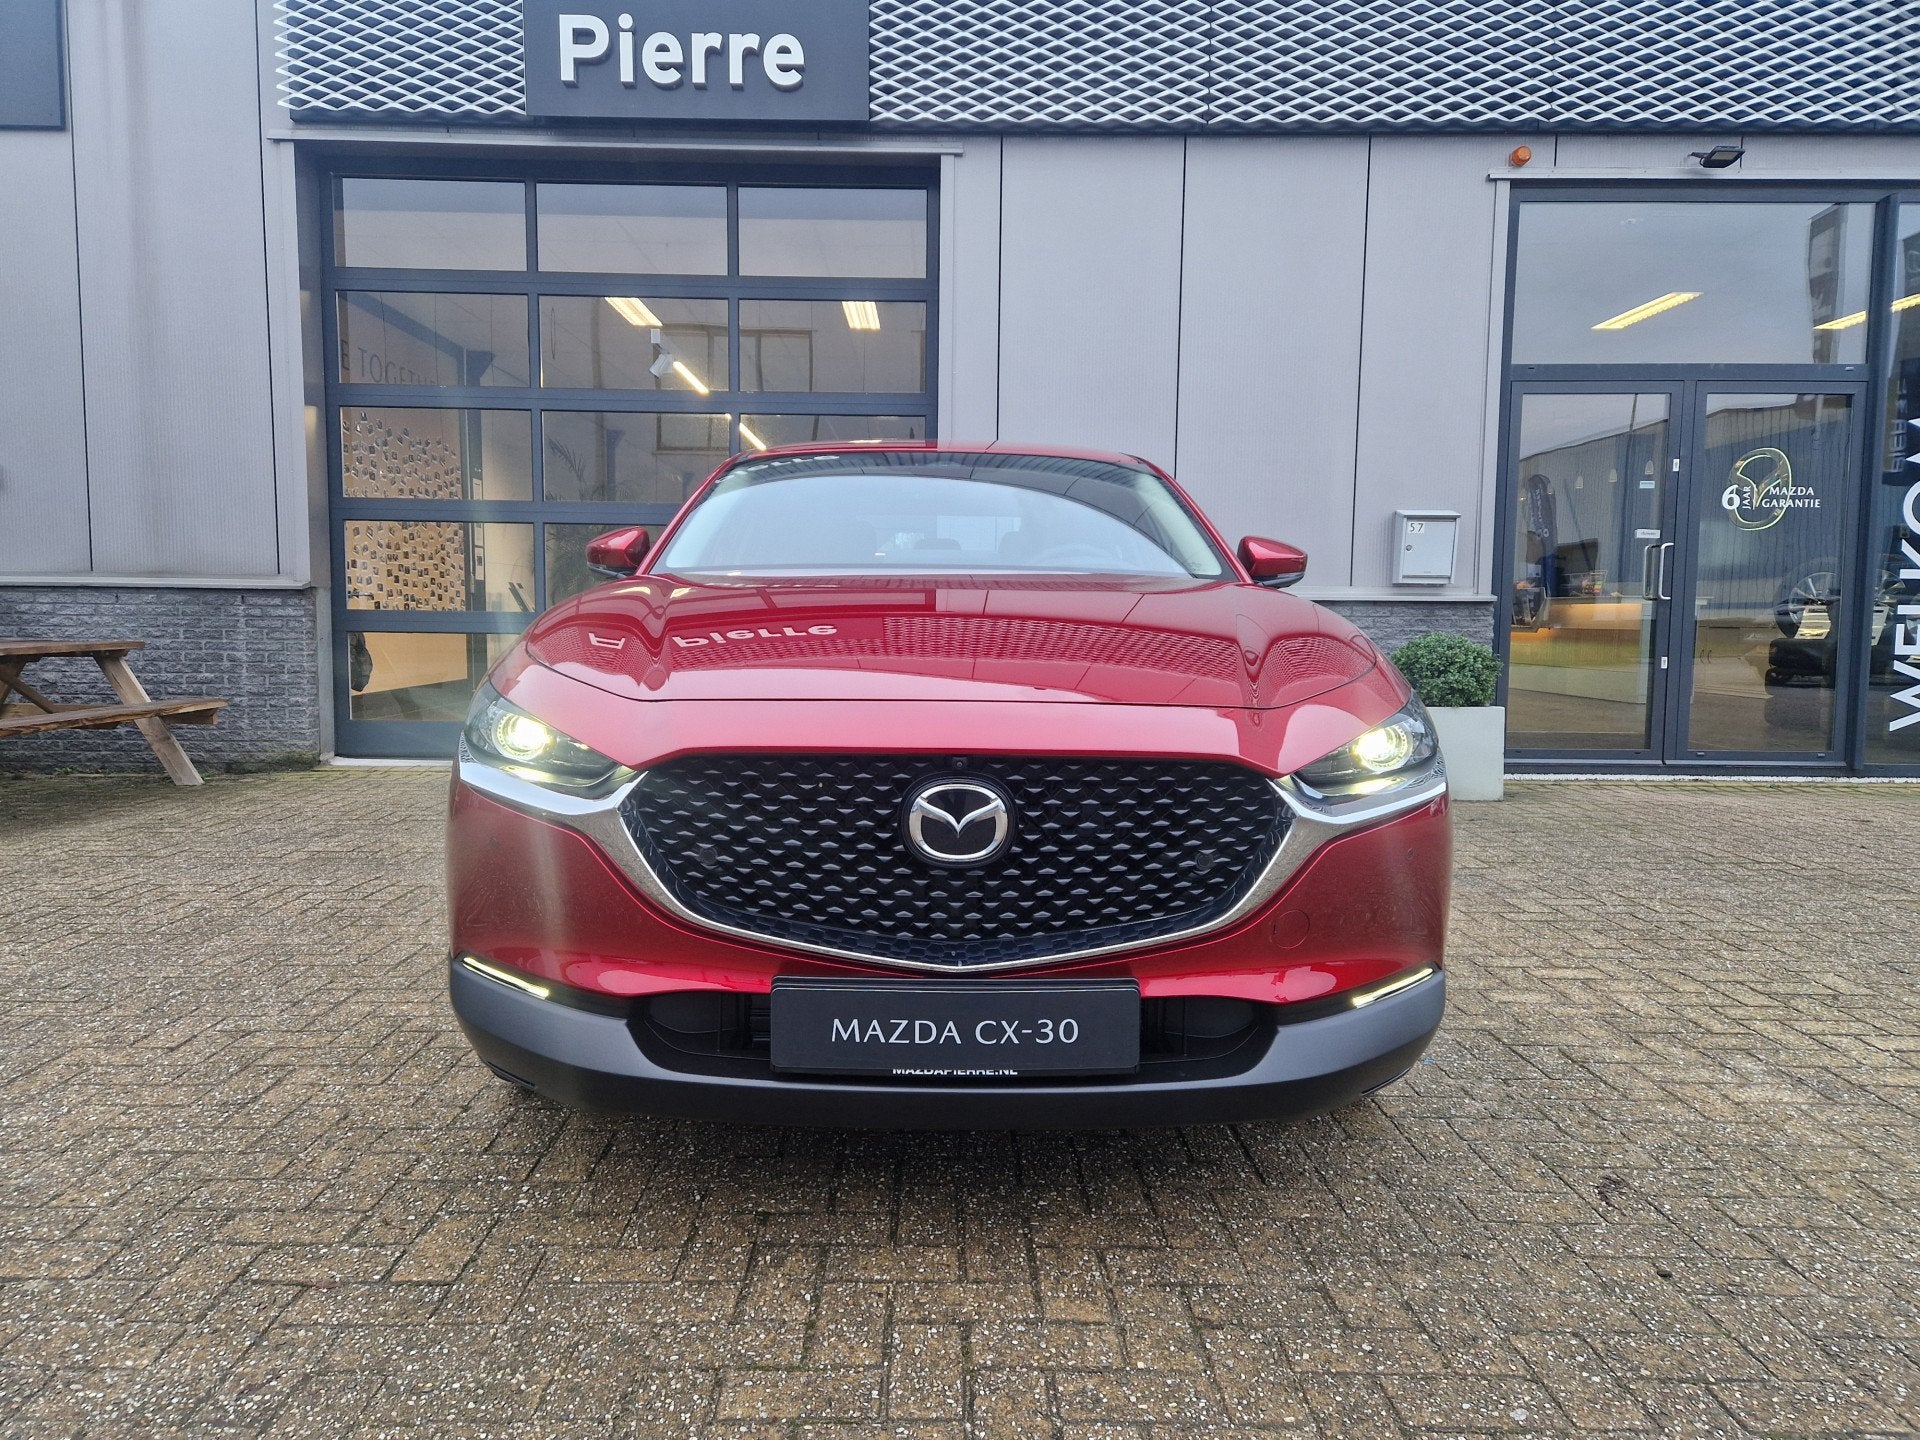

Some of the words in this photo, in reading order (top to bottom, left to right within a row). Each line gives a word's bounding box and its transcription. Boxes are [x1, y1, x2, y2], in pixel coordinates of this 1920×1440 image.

[558, 13, 805, 88] Pierre
[1721, 484, 1740, 510] 6
[1742, 486, 1752, 509] JAAR
[1768, 486, 1815, 496] MAZDA
[1761, 498, 1821, 508] GARANTIE
[1410, 522, 1424, 533] 57
[831, 1018, 962, 1044] MAZDA
[975, 1018, 1080, 1045] CX-30
